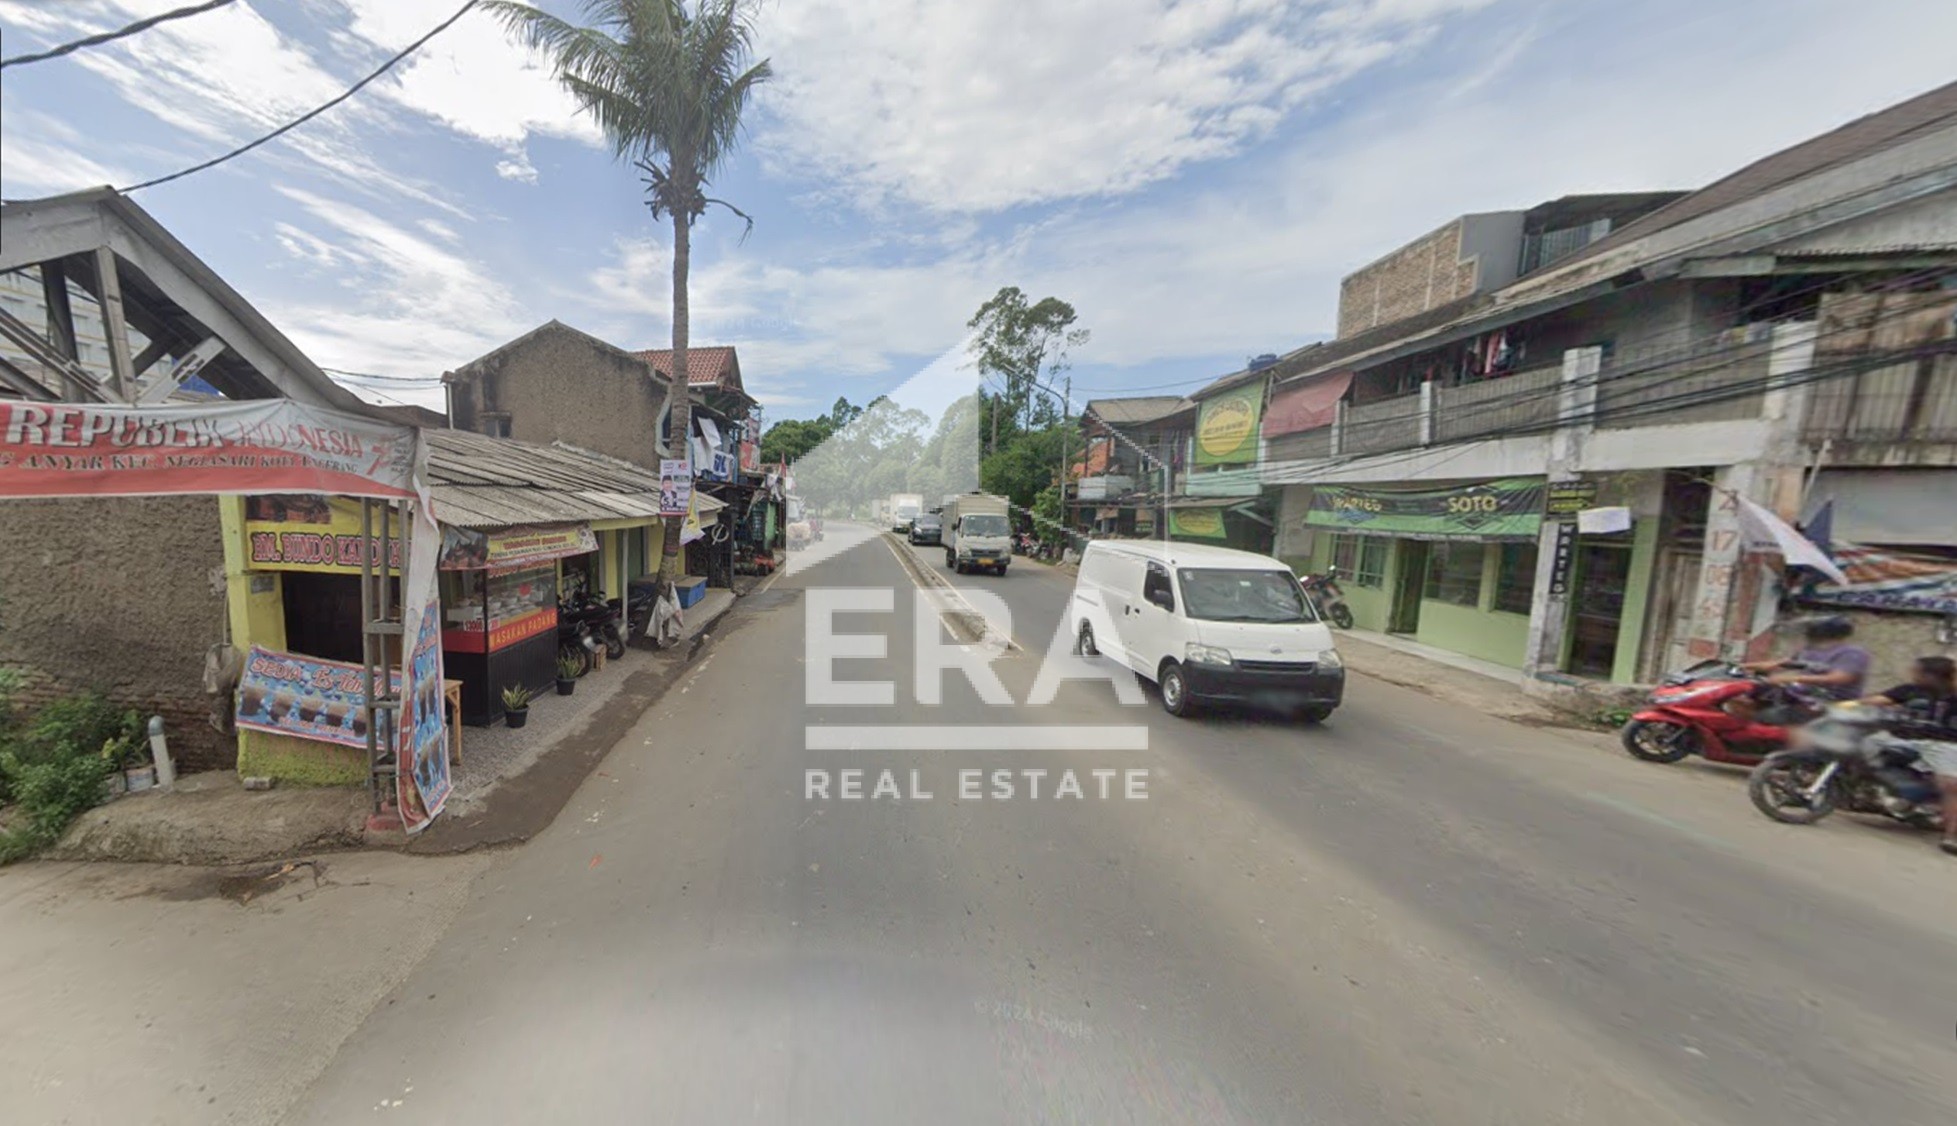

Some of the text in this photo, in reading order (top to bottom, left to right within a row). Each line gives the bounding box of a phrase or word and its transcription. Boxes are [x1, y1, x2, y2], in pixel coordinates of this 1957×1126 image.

[1447, 495, 1498, 513] SOTO
[281, 533, 335, 565] BUNDO
[251, 657, 301, 682] SEDIA
[312, 668, 334, 689] Es
